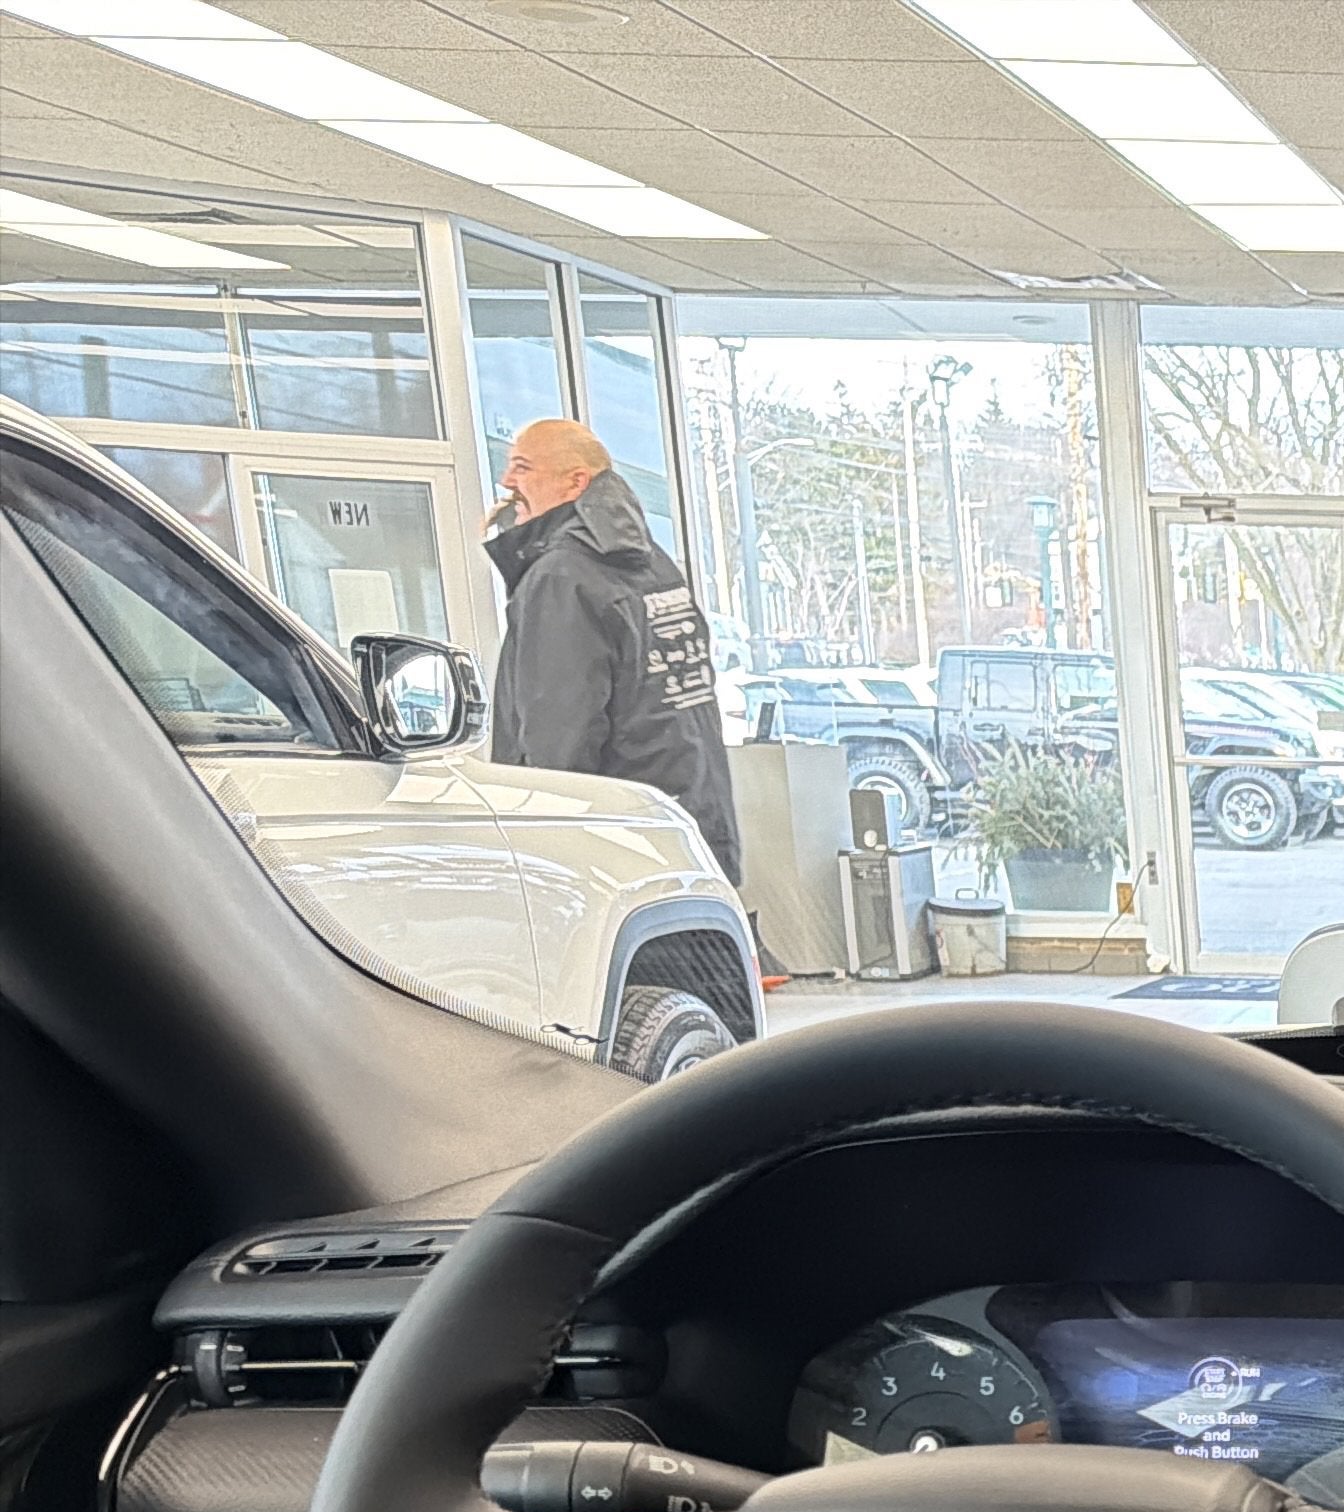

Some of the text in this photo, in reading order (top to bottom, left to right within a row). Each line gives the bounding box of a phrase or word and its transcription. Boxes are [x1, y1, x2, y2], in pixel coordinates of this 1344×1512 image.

[930, 1361, 946, 1381] 4
[881, 1377, 898, 1396] 3
[979, 1376, 995, 1396] 5
[850, 1407, 867, 1426] 2
[1008, 1406, 1024, 1425] 6
[1178, 1411, 1258, 1425] Press Brake
[1203, 1429, 1230, 1441] and
[1212, 1448, 1259, 1459] Button
